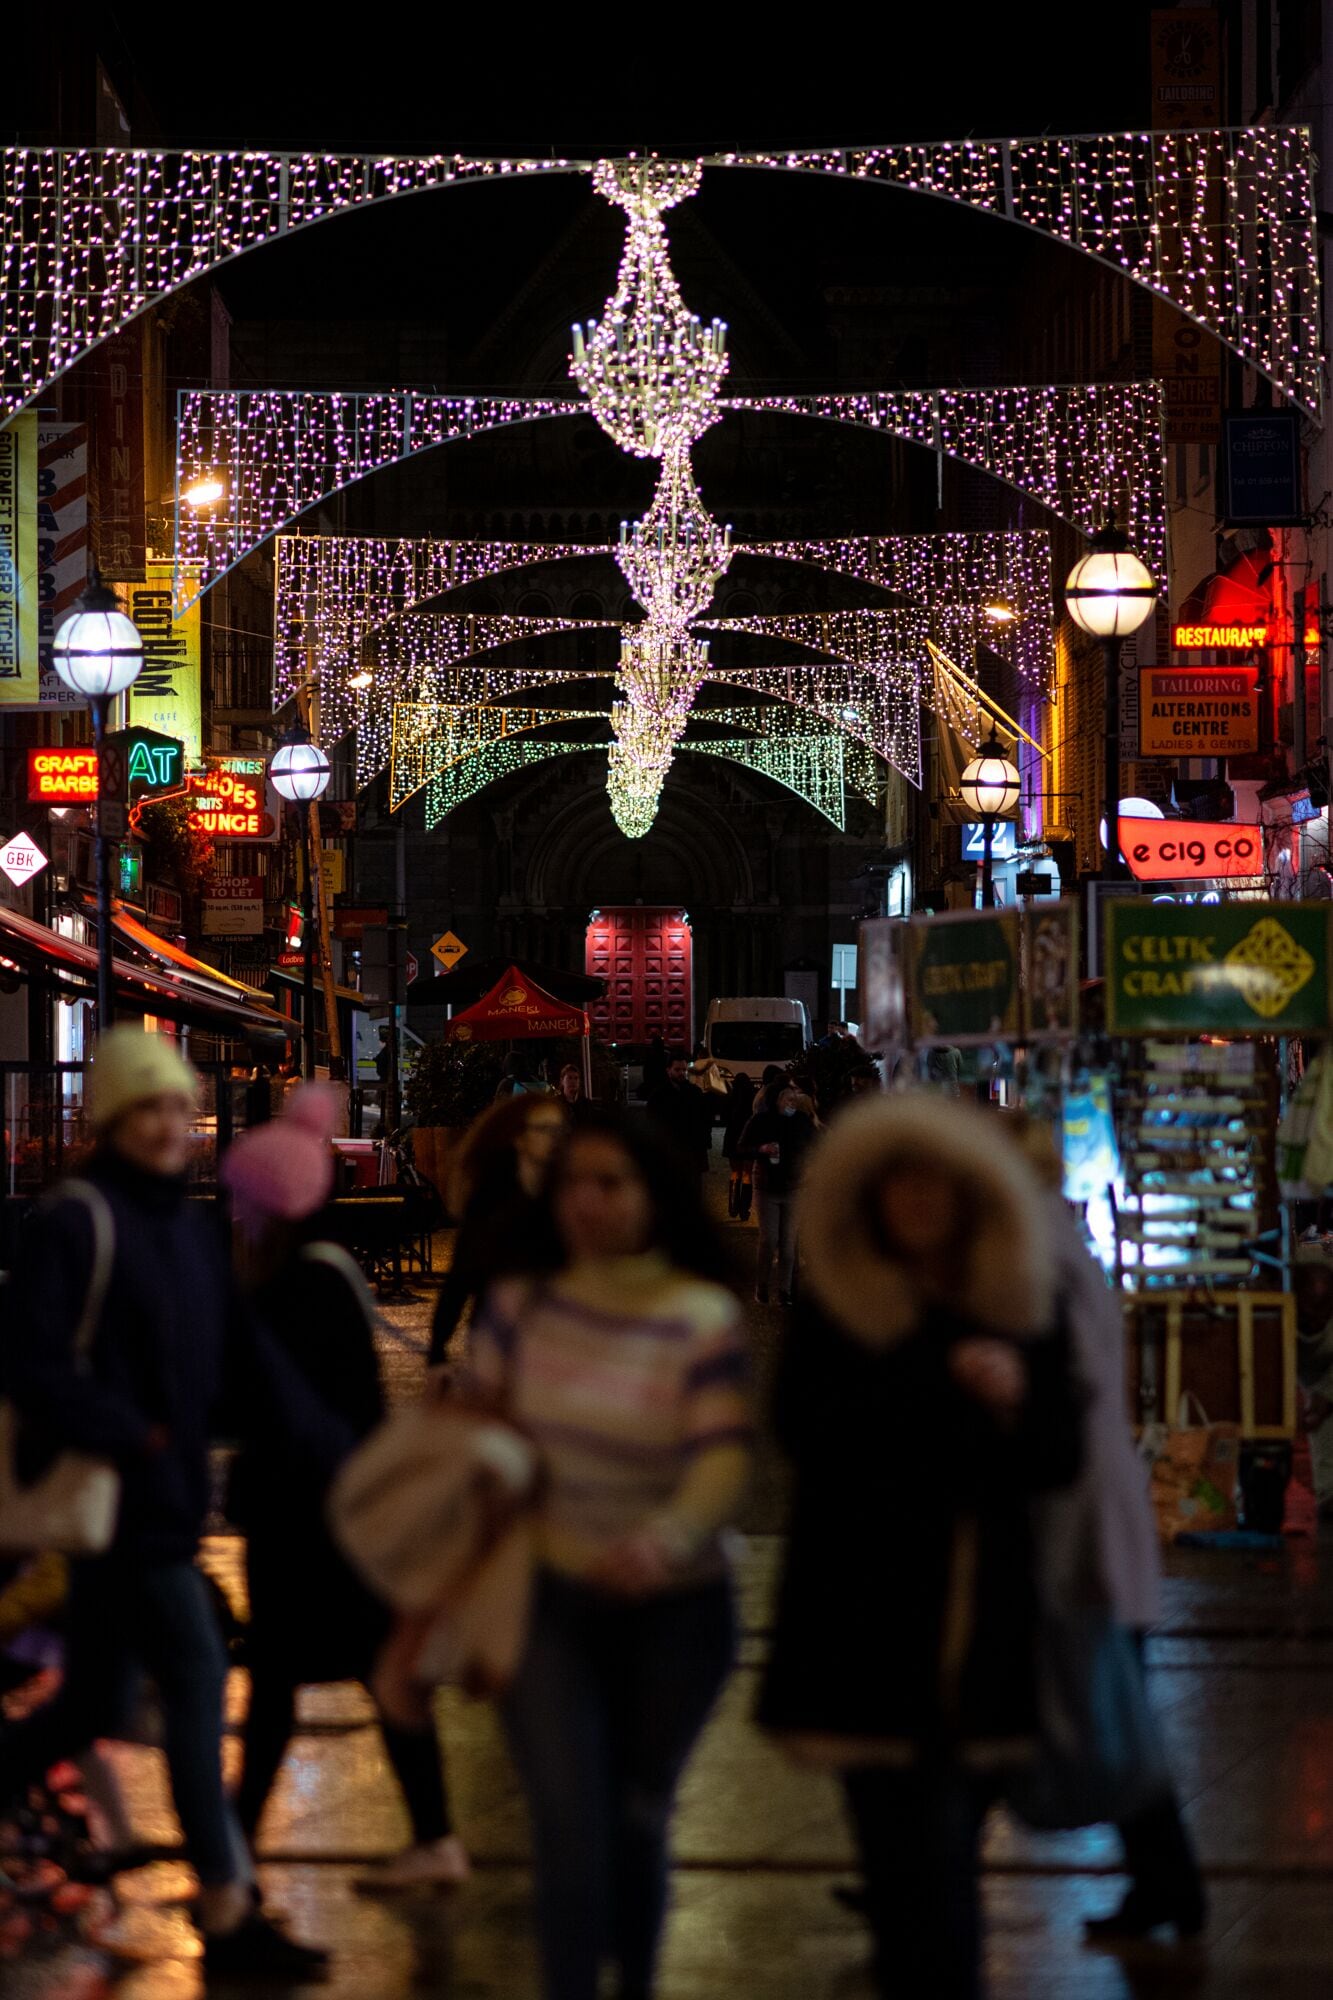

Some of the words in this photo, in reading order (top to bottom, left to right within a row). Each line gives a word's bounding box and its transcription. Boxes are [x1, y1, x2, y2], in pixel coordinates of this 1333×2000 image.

[1159, 86, 1215, 100] TAILORING
[1168, 380, 1215, 401] ENTRE
[0, 431, 12, 518] GOURMET
[0, 524, 12, 594] BURGER
[0, 601, 13, 675] KITCHEN
[133, 591, 194, 696] GOTHAM
[1176, 627, 1266, 647] RESTAURANT
[1120, 635, 1138, 670] Clin
[1160, 679, 1241, 693] TAILORING
[39, 691, 76, 702] RBER
[1120, 676, 1138, 732] Trinity
[1151, 702, 1252, 717] ALTERATIONS
[1172, 721, 1230, 736] CENTRE
[1151, 740, 1193, 749] LADIES
[1198, 740, 1205, 749] &
[1210, 740, 1251, 749] GENTS
[34, 755, 97, 773] GRAFT
[129, 742, 178, 784] AT
[40, 775, 98, 793] BARBE
[187, 812, 259, 833] OUNGE
[967, 823, 1007, 852] 22
[6, 851, 34, 867] GBK
[1132, 844, 1151, 863] e
[1158, 841, 1206, 867] cig
[1214, 838, 1254, 859] co
[215, 878, 250, 887] SHOP
[209, 888, 228, 897] TO
[231, 888, 255, 897] LET
[282, 955, 305, 965] Ladbro
[486, 1005, 540, 1016] MANEKI
[528, 1018, 578, 1032] MANEKI
